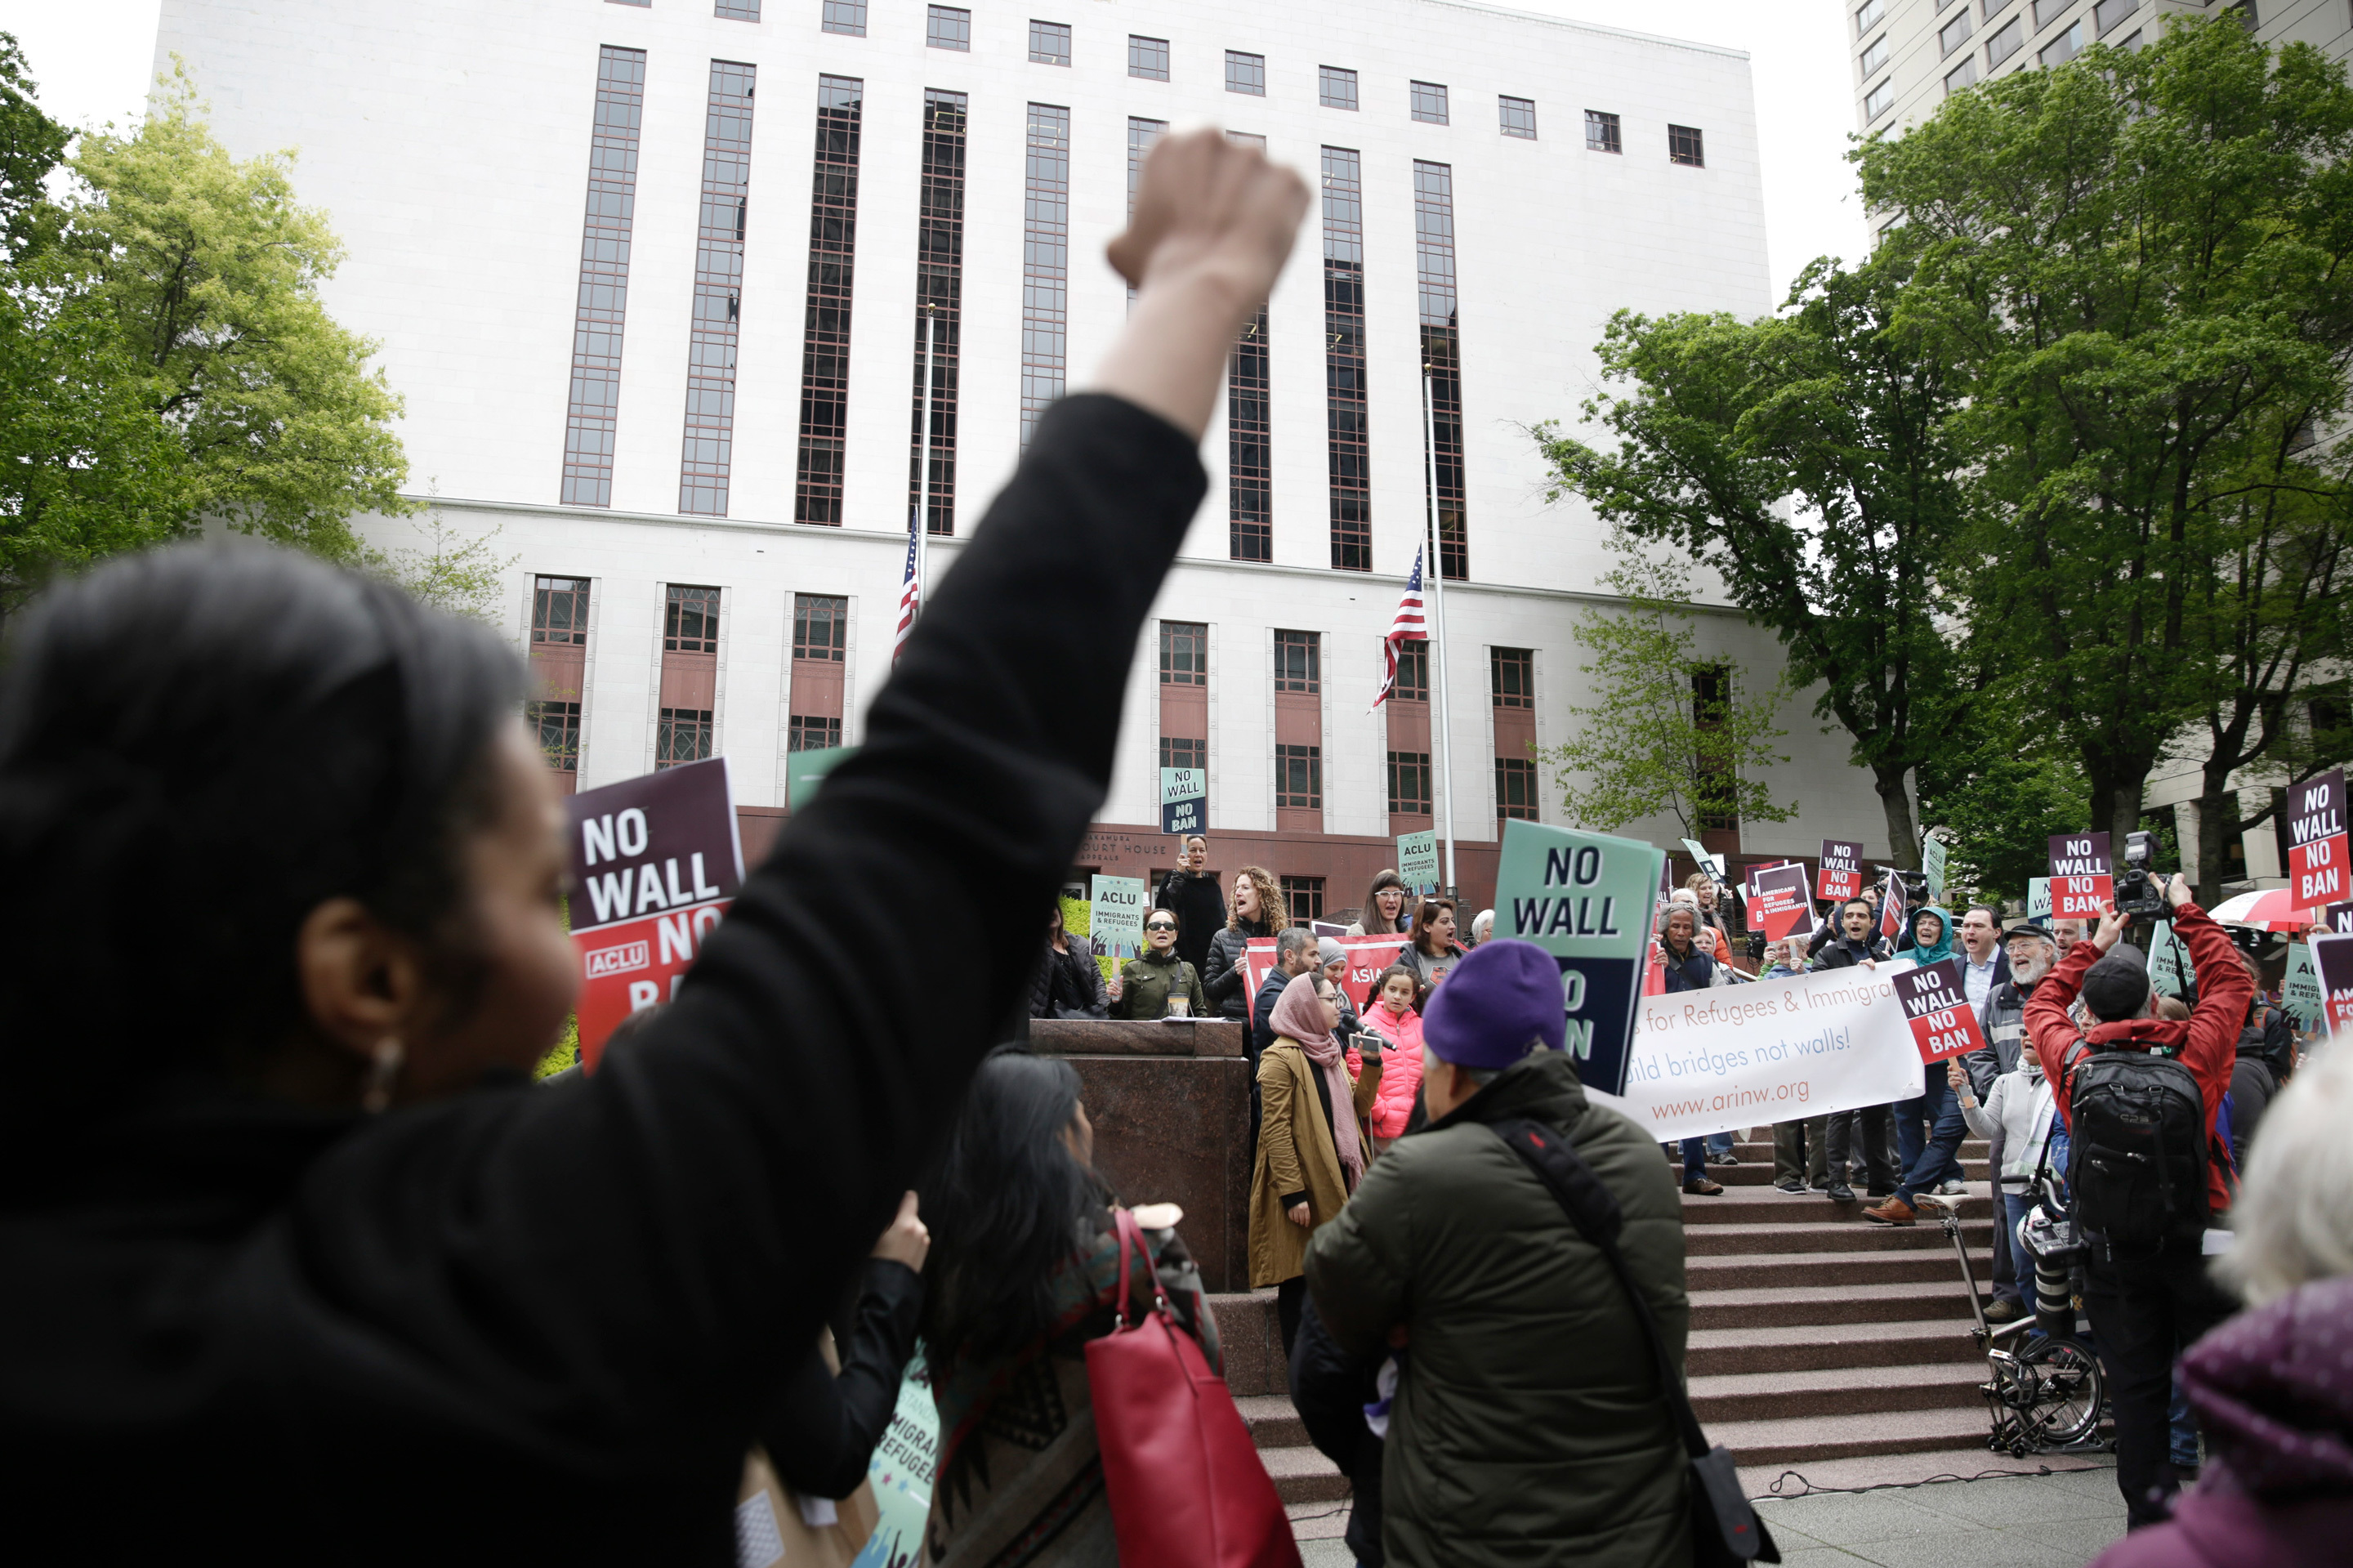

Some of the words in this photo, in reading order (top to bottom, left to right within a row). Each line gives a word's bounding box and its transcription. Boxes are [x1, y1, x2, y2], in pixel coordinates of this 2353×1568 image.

[1175, 770, 1191, 784] NO
[1168, 782, 1200, 797] WALL
[2305, 784, 2329, 813] NO
[1175, 802, 1193, 818] NO
[1171, 815, 1197, 833] BAN
[2292, 808, 2342, 845] WALL
[582, 807, 649, 867] NO
[1082, 842, 1117, 852] OURT
[1124, 845, 1167, 855] HOUSE
[1404, 843, 1431, 856] ACLU
[1833, 844, 1851, 858] NO
[2066, 839, 2092, 856] NO
[2306, 840, 2331, 869] NO
[1401, 858, 1435, 868] IMMIGRANTS
[1408, 864, 1434, 872] REFUGEES
[1544, 846, 1602, 889] NO
[1824, 856, 1858, 872] WALL
[2055, 858, 2106, 875] WALL
[1830, 871, 1848, 884] NO
[2068, 877, 2094, 894] NO
[2302, 867, 2339, 900] BAN
[586, 852, 721, 922] WALL
[1761, 886, 1797, 897] AMERICANS
[1824, 883, 1851, 898] BAN
[2043, 883, 2051, 894] N
[1100, 891, 1136, 905] ACLU
[1763, 898, 1795, 909] REFUGEES
[2034, 896, 2052, 911] WA
[2063, 896, 2101, 913] BAN
[1096, 911, 1140, 921] IMMIGRANTS
[1770, 902, 1808, 914] IMMIGRANTS
[1104, 918, 1138, 927] REFUGEES
[1514, 896, 1622, 938] WALL
[2043, 917, 2052, 930] N
[2337, 911, 2353, 933] N
[2164, 936, 2188, 950] AC
[592, 945, 644, 974] ACLU
[2156, 956, 2196, 971] IMMIRA
[1351, 967, 1387, 983] ASIA
[1912, 970, 1941, 994] NO
[1562, 968, 1587, 1012] O
[2288, 982, 2320, 993] IMMIG
[2298, 991, 2321, 1000] REFU
[1906, 987, 1963, 1016] WALL
[1645, 1008, 1676, 1032] for
[1684, 999, 1777, 1027] Refugees
[1784, 990, 1801, 1012] &
[2335, 1004, 2353, 1017] FO
[1927, 1010, 1956, 1033] NO
[1928, 1027, 1971, 1054] BAN
[1665, 1048, 1748, 1076] bridges
[1755, 1039, 1788, 1062] not
[1794, 1025, 1851, 1057] walls!
[1651, 1080, 1810, 1120] www.arinw.org
[891, 1413, 937, 1458] MIGRA
[877, 1432, 935, 1485] REFUGEE
